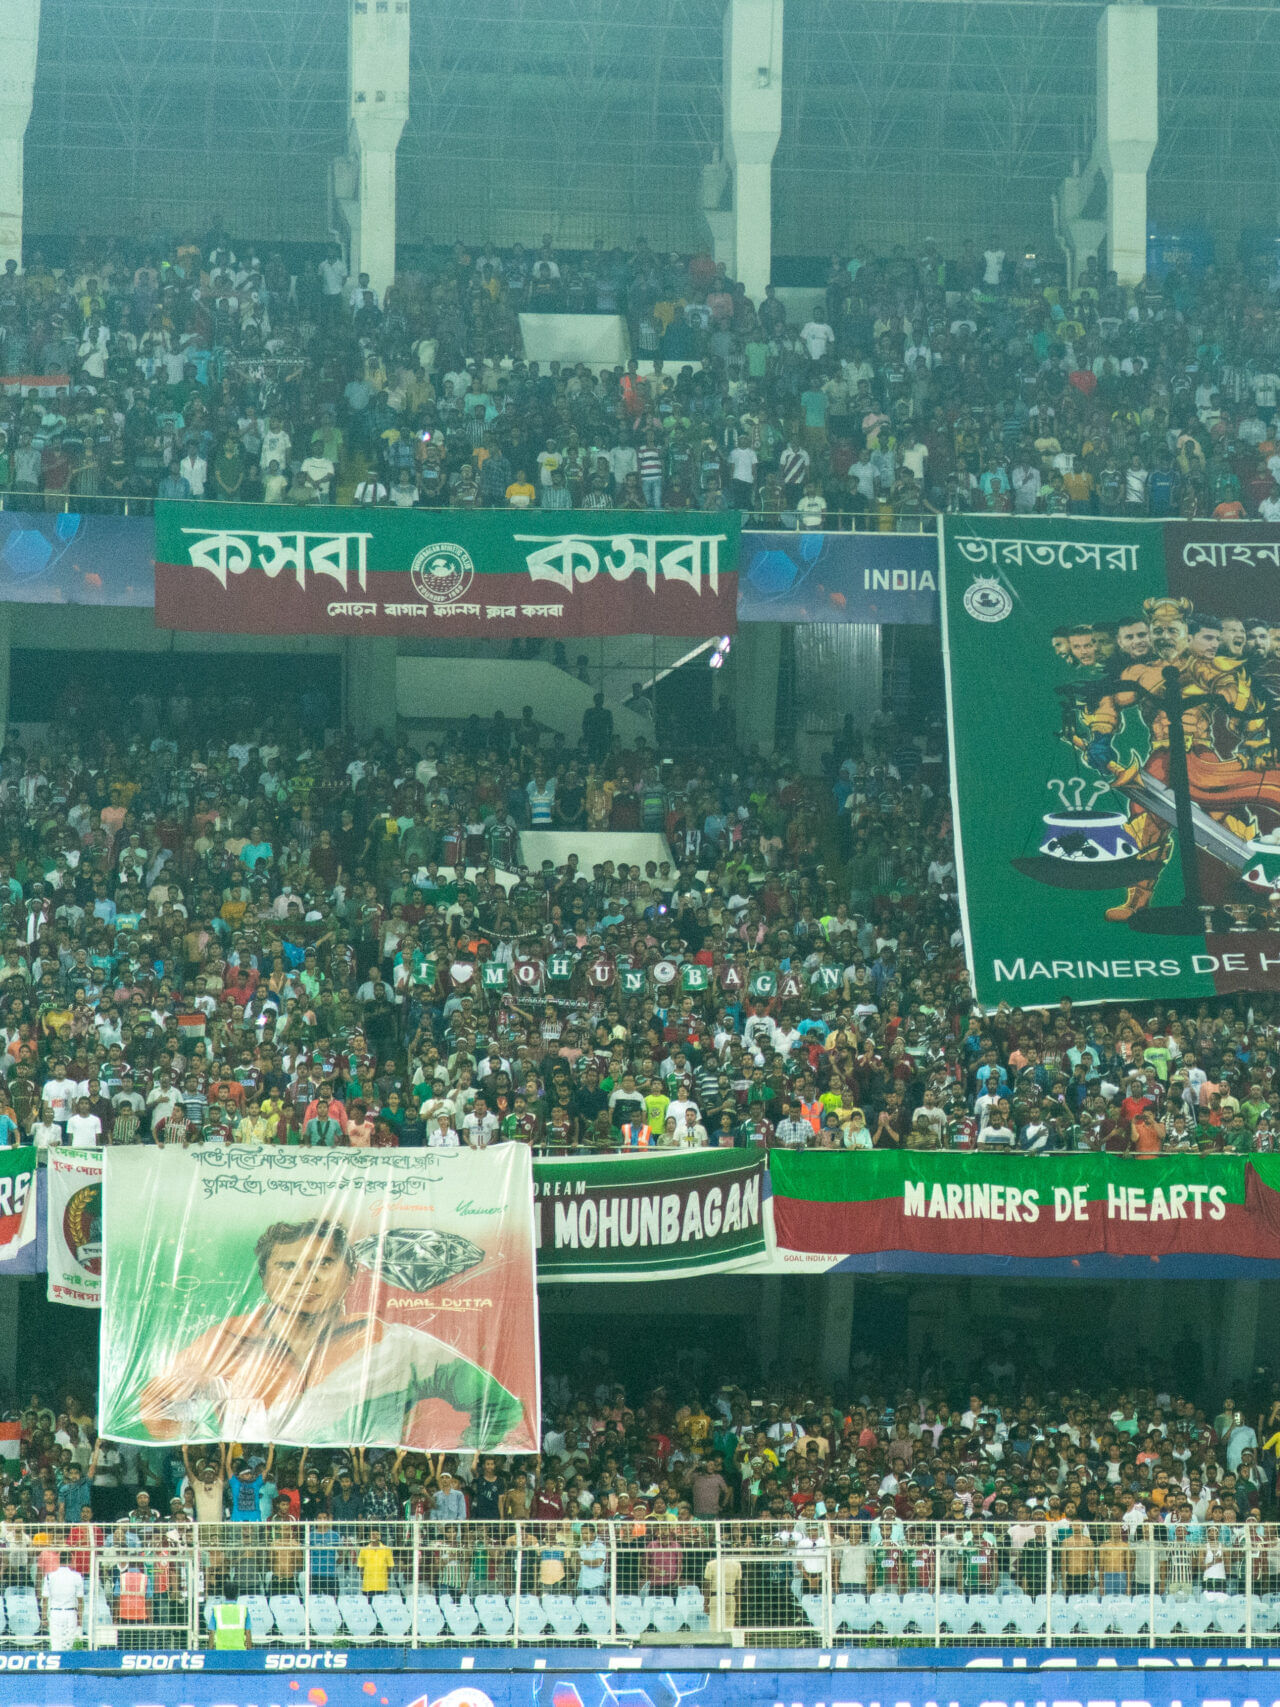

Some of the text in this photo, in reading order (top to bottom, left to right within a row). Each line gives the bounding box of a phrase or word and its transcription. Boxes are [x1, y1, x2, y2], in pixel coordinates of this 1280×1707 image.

[180, 528, 728, 597] কসবা কসবা
[953, 535, 1140, 571] ভারতসেরা
[327, 602, 377, 619] মোহন
[384, 603, 428, 617] বাগান
[520, 605, 564, 617] কসবা
[993, 957, 1181, 982] MARINERS
[1192, 953, 1246, 974] DE
[554, 1173, 760, 1249] MOHUNBAGAN
[903, 1180, 1040, 1223] MARINERS
[1107, 1183, 1228, 1222] HEARTS
[386, 1298, 493, 1309] AMAL DUTTA
[121, 1651, 206, 1670] sports
[264, 1650, 348, 1669] sports
